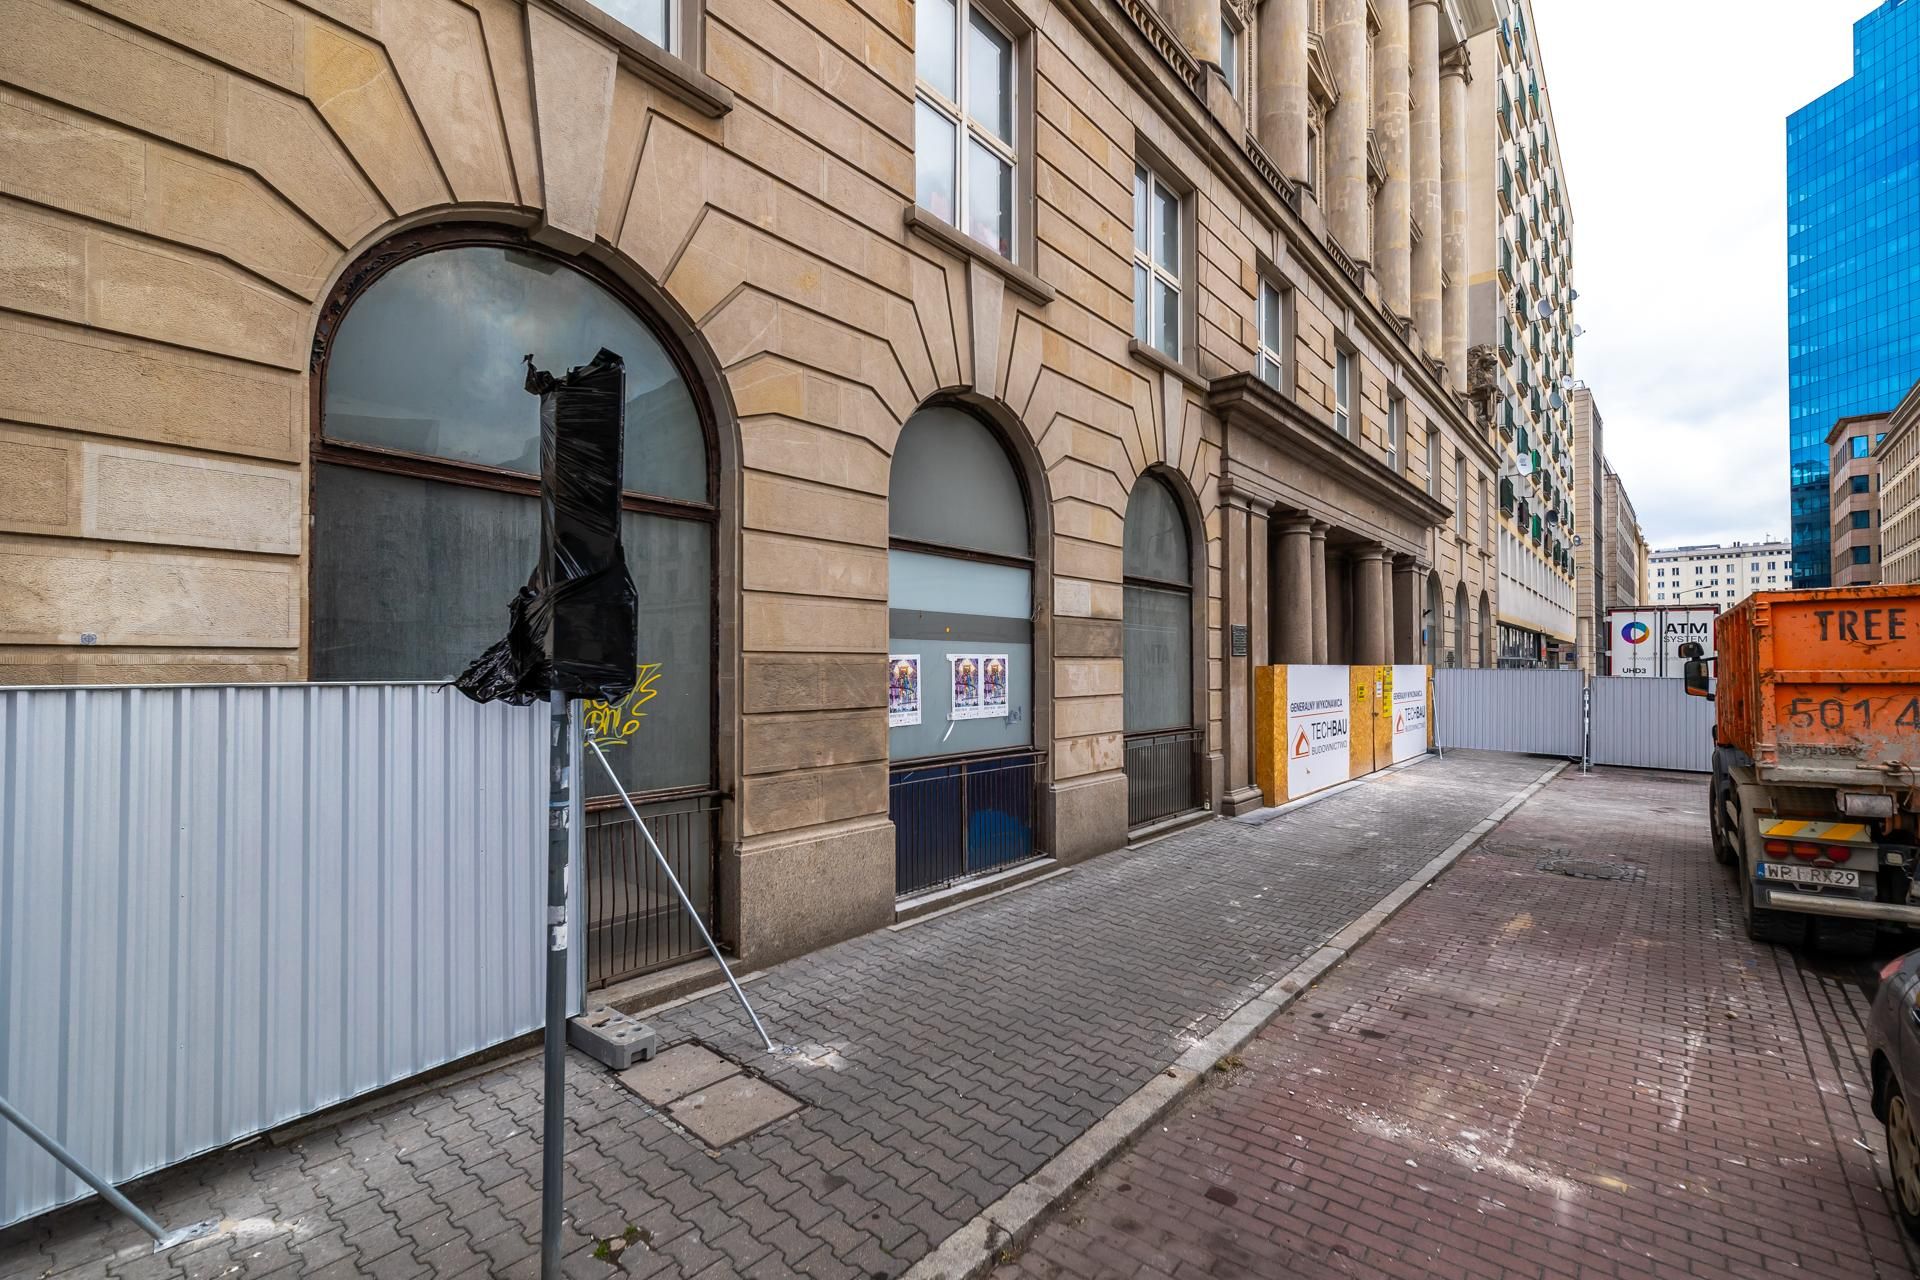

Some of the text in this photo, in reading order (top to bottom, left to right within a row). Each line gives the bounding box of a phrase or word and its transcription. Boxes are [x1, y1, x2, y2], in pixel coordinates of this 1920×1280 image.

[1664, 622, 1708, 635] ATM
[1814, 608, 1907, 641] TREE
[1663, 635, 1708, 643] SYSTEM
[1290, 699, 1343, 712] GENERALNY WYKONAWCA
[1405, 705, 1425, 721] TECHBAU
[1311, 719, 1348, 740] TECHBAU
[1311, 740, 1348, 756] BUDOWNICTWO
